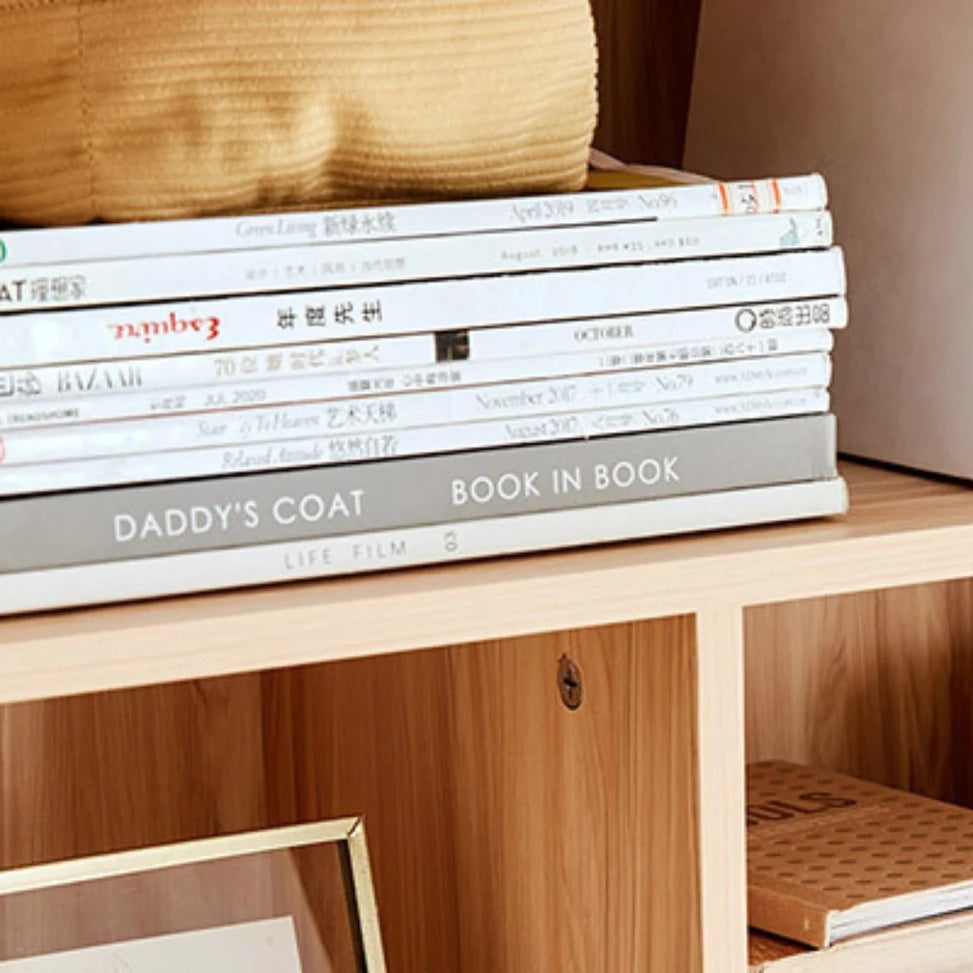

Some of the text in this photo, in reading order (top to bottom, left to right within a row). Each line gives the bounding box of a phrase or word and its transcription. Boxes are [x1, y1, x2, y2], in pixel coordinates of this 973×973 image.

[106, 312, 221, 343] Esquire
[574, 324, 635, 341] OCTOBER
[476, 386, 544, 413] November
[114, 456, 681, 542] DADDY'S COAT BOOK IN BOOK
[284, 550, 332, 570] LIFE
[353, 541, 408, 561] FILM
